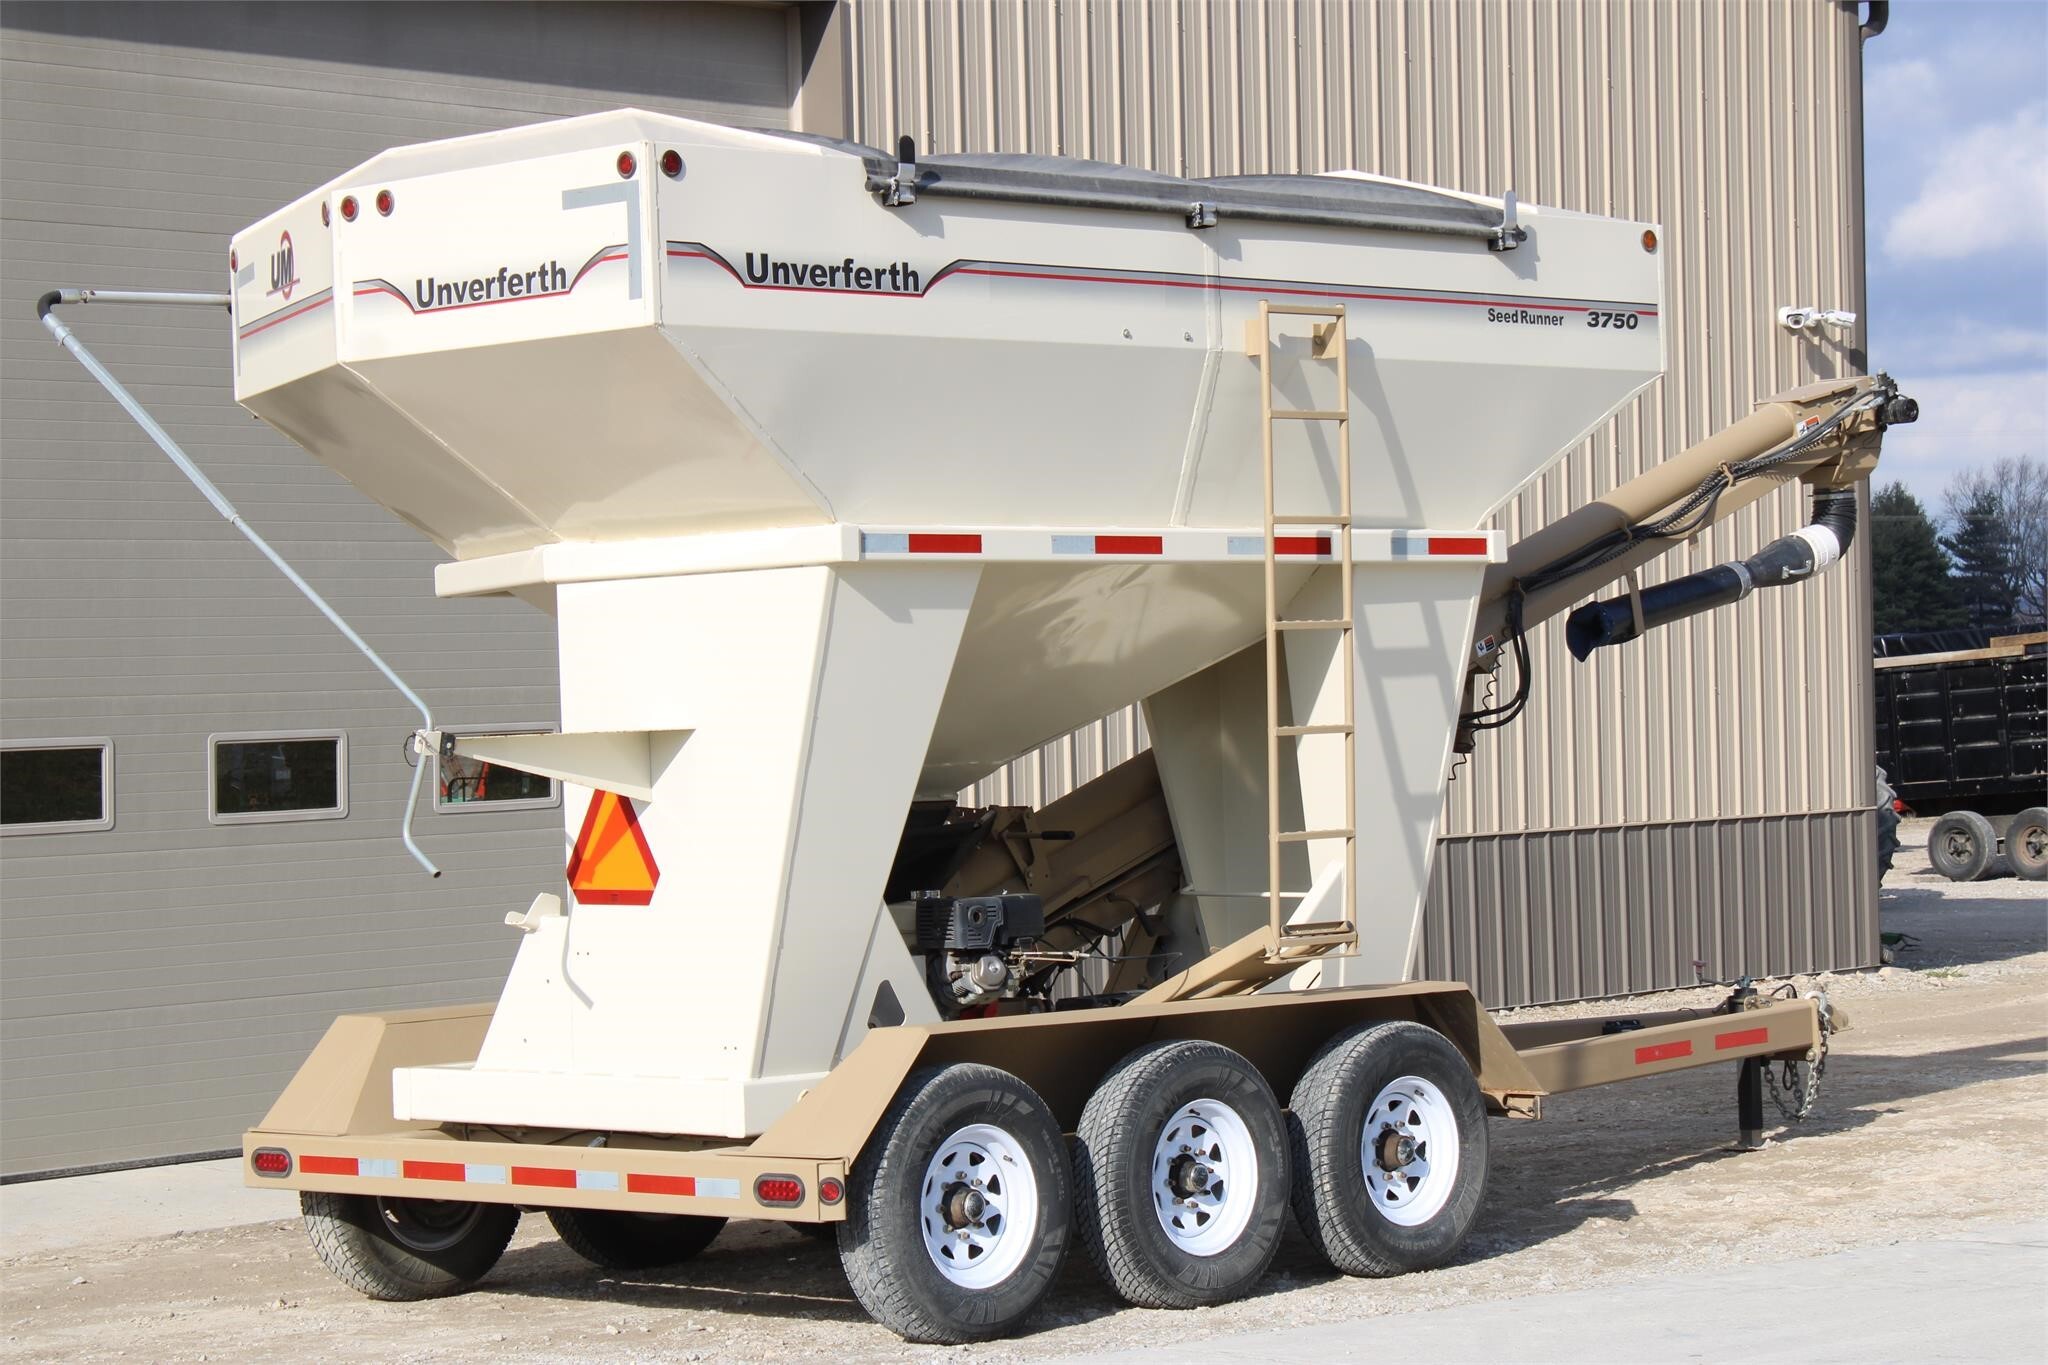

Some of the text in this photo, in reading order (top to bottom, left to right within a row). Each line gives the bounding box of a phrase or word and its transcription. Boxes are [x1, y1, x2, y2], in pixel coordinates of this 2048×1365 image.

[271, 247, 292, 290] UM
[416, 260, 567, 308] Unverferth
[745, 252, 920, 292] Unverferth
[1587, 311, 1639, 330] 3750
